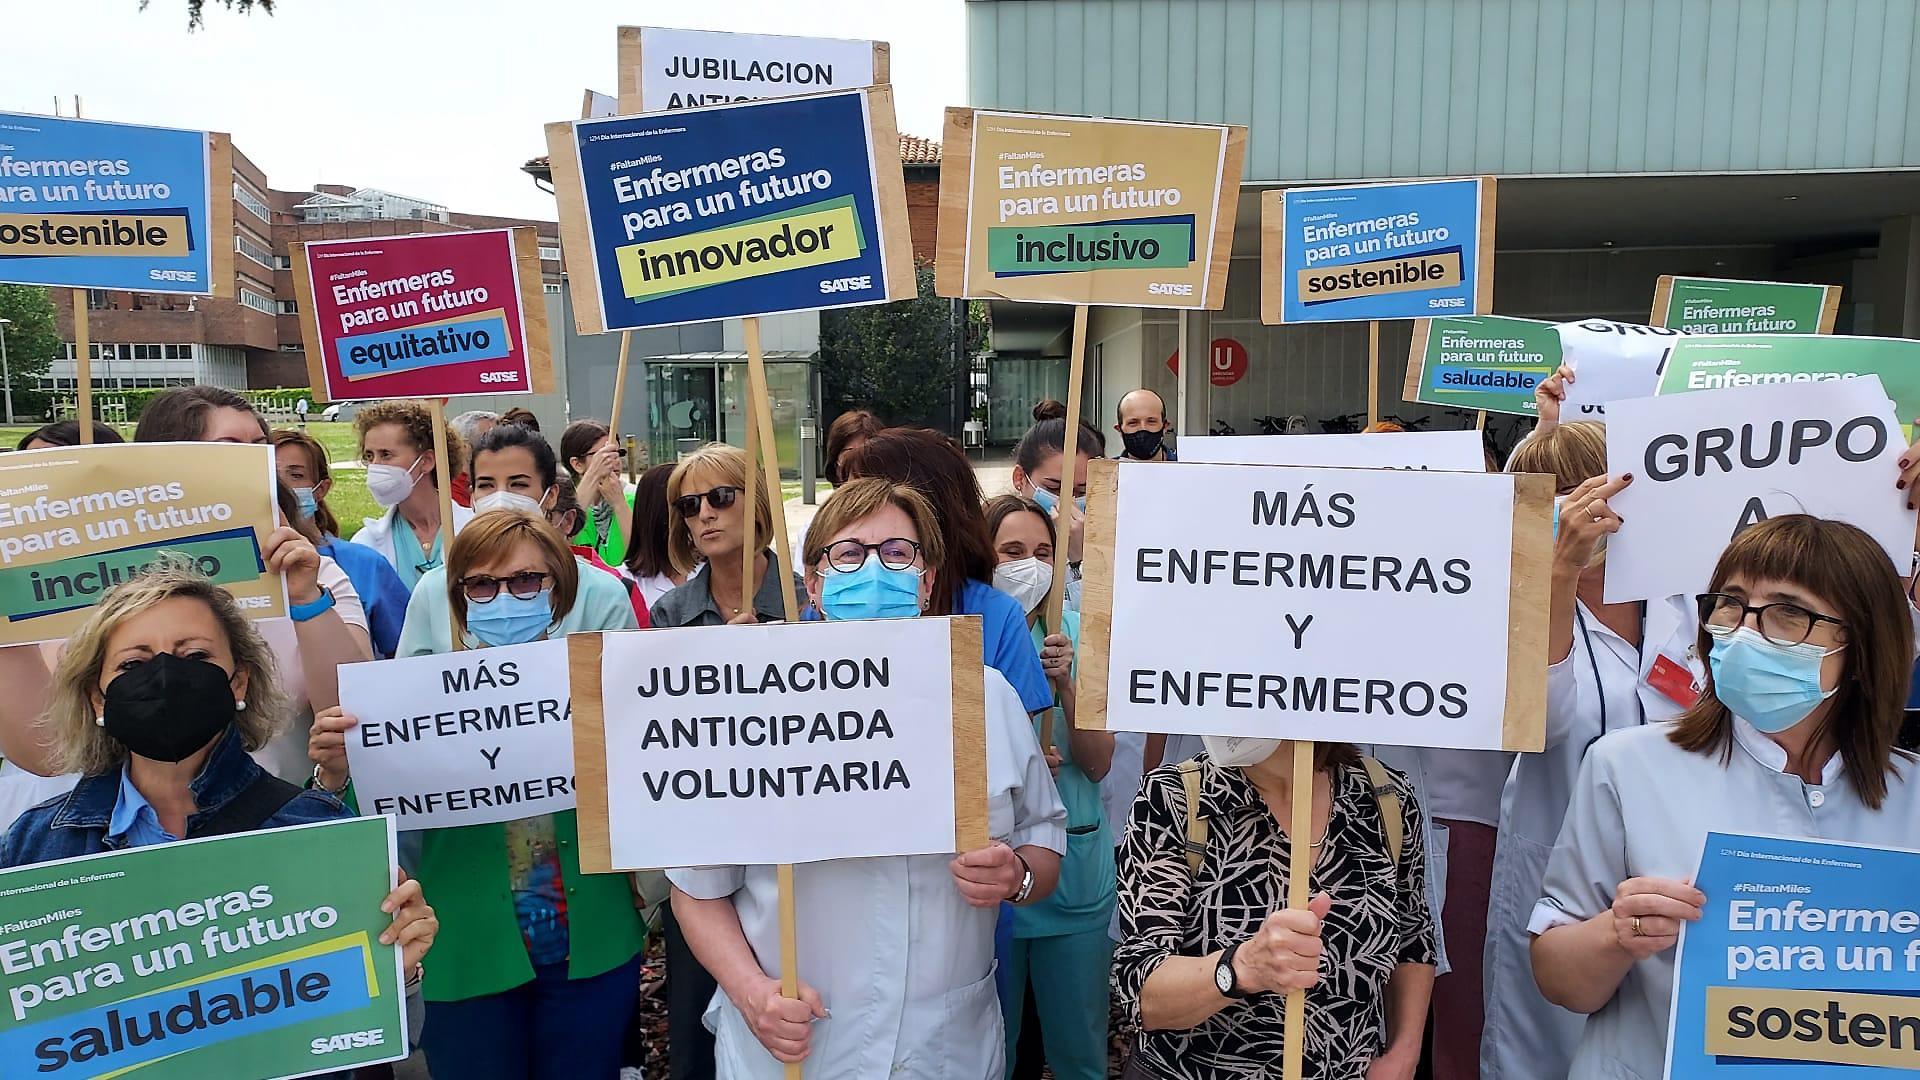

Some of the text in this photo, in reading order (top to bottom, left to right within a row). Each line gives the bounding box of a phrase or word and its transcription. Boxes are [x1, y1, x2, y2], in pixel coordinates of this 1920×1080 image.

[665, 55, 833, 86] JUBILACION
[0, 155, 130, 177] fermeras
[610, 154, 663, 171] #FaltanMiles
[613, 147, 785, 204] Enfermeras
[998, 162, 1146, 190] Enfermeras
[42, 184, 79, 201] un
[84, 179, 170, 201] futuro
[622, 168, 832, 241] para un futuro
[999, 186, 1181, 223] para un futuro
[1303, 211, 1420, 243] Enfermeras
[638, 223, 834, 282] innovador
[1016, 232, 1160, 263] inclusivo
[1305, 226, 1449, 267] para un futuro
[149, 269, 198, 282] SATSE
[332, 268, 455, 306] Enfermeras
[819, 275, 872, 294] SATSE
[1148, 282, 1193, 296] SATSE
[1308, 259, 1444, 293] sostenible
[339, 287, 488, 334] para un futuro
[1428, 297, 1466, 308] SATSE
[1683, 305, 1776, 320] Enfermeras
[1441, 336, 1525, 349] Enfermeras
[1721, 321, 1742, 333] un
[1745, 318, 1797, 332] futuro
[349, 328, 490, 369] equitativo
[1215, 347, 1232, 370] U
[1440, 350, 1544, 364] para un futuro
[480, 371, 519, 384] SATSE
[1442, 370, 1535, 388] saludable
[1644, 415, 1888, 482] GRUPO
[0, 481, 184, 528] Enfermeras
[1252, 483, 1356, 528] MÁS
[1730, 496, 1770, 544] A
[0, 503, 232, 564] para un futuro
[1136, 548, 1471, 595] ENFERMERAS
[1284, 613, 1313, 650] Y
[442, 659, 520, 694] MÁS
[637, 656, 890, 698] JUBILACION
[1129, 669, 1469, 719] ENFERMEROS
[640, 709, 894, 750] ANTICIPADA
[480, 746, 502, 770] Y
[374, 775, 576, 817] ENFERMER
[642, 759, 911, 802] VOLUNTARIA
[1750, 851, 1801, 863] Internacional
[1801, 856, 1812, 864] de
[1813, 857, 1821, 865] la
[57, 879, 70, 887] de
[79, 870, 126, 883] Enfermera
[1733, 883, 1812, 894] #FaltanMiles
[0, 883, 273, 976] Enfermeras
[1728, 900, 1920, 934] Enferme
[8, 905, 338, 1021] para un futuro
[1727, 944, 1825, 980] para
[1836, 945, 1892, 972] un
[34, 968, 330, 1074] saludable
[1727, 1000, 1920, 1051] sosten
[310, 1027, 385, 1055] SATSE
